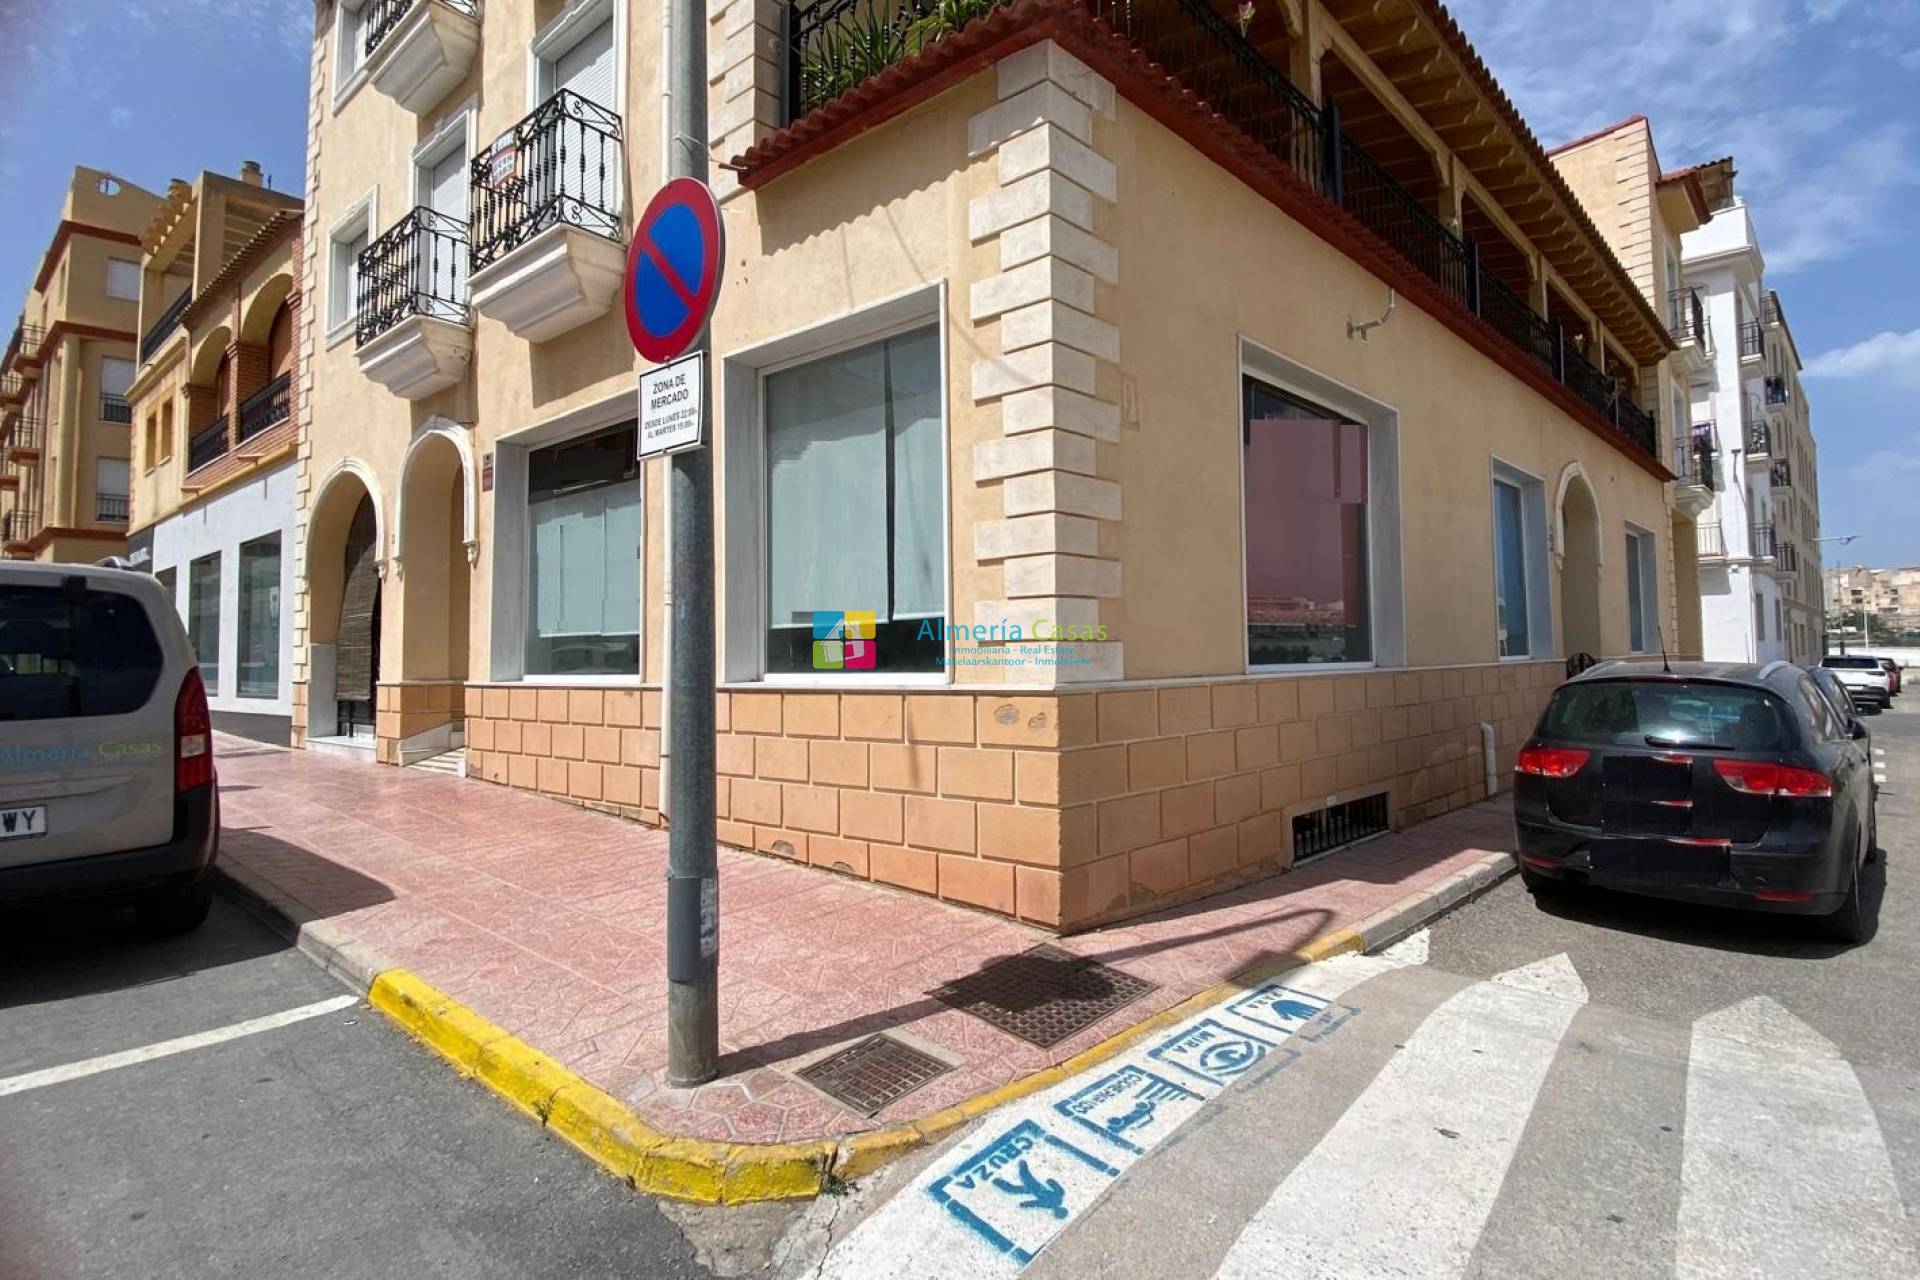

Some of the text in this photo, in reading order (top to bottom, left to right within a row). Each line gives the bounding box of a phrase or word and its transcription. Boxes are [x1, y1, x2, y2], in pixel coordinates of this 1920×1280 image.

[653, 373, 687, 394] ZONA DE
[651, 389, 689, 409] MERCADO
[662, 411, 680, 425] LUNES
[655, 423, 676, 436] MARTES
[98, 741, 161, 757] Casas
[2, 809, 36, 832] WY
[1172, 1031, 1216, 1054] MIRA
[954, 1136, 1034, 1189] CRUZA
